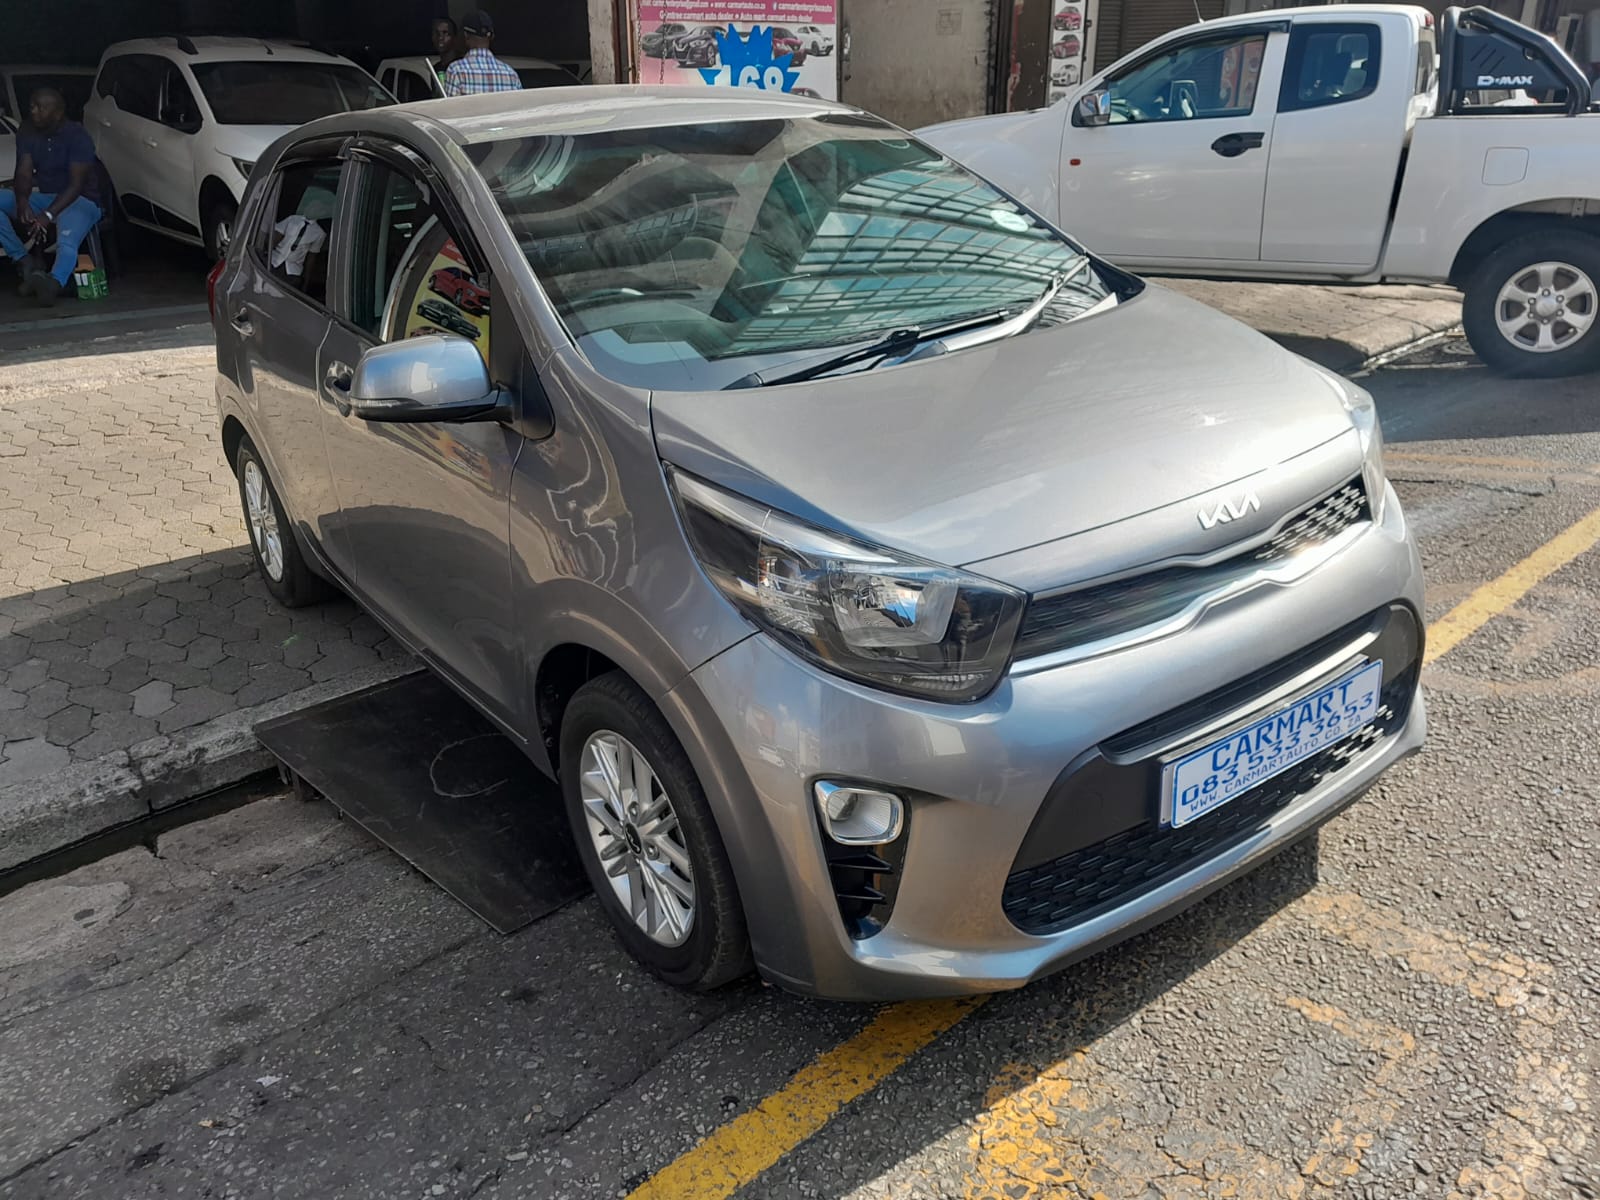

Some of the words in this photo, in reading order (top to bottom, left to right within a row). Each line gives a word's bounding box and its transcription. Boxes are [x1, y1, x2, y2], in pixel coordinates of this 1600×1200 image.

[1181, 763, 1239, 807] 083
[1248, 729, 1301, 771] 533
[1309, 691, 1374, 738] 3653
[1212, 680, 1353, 772] CARMART
